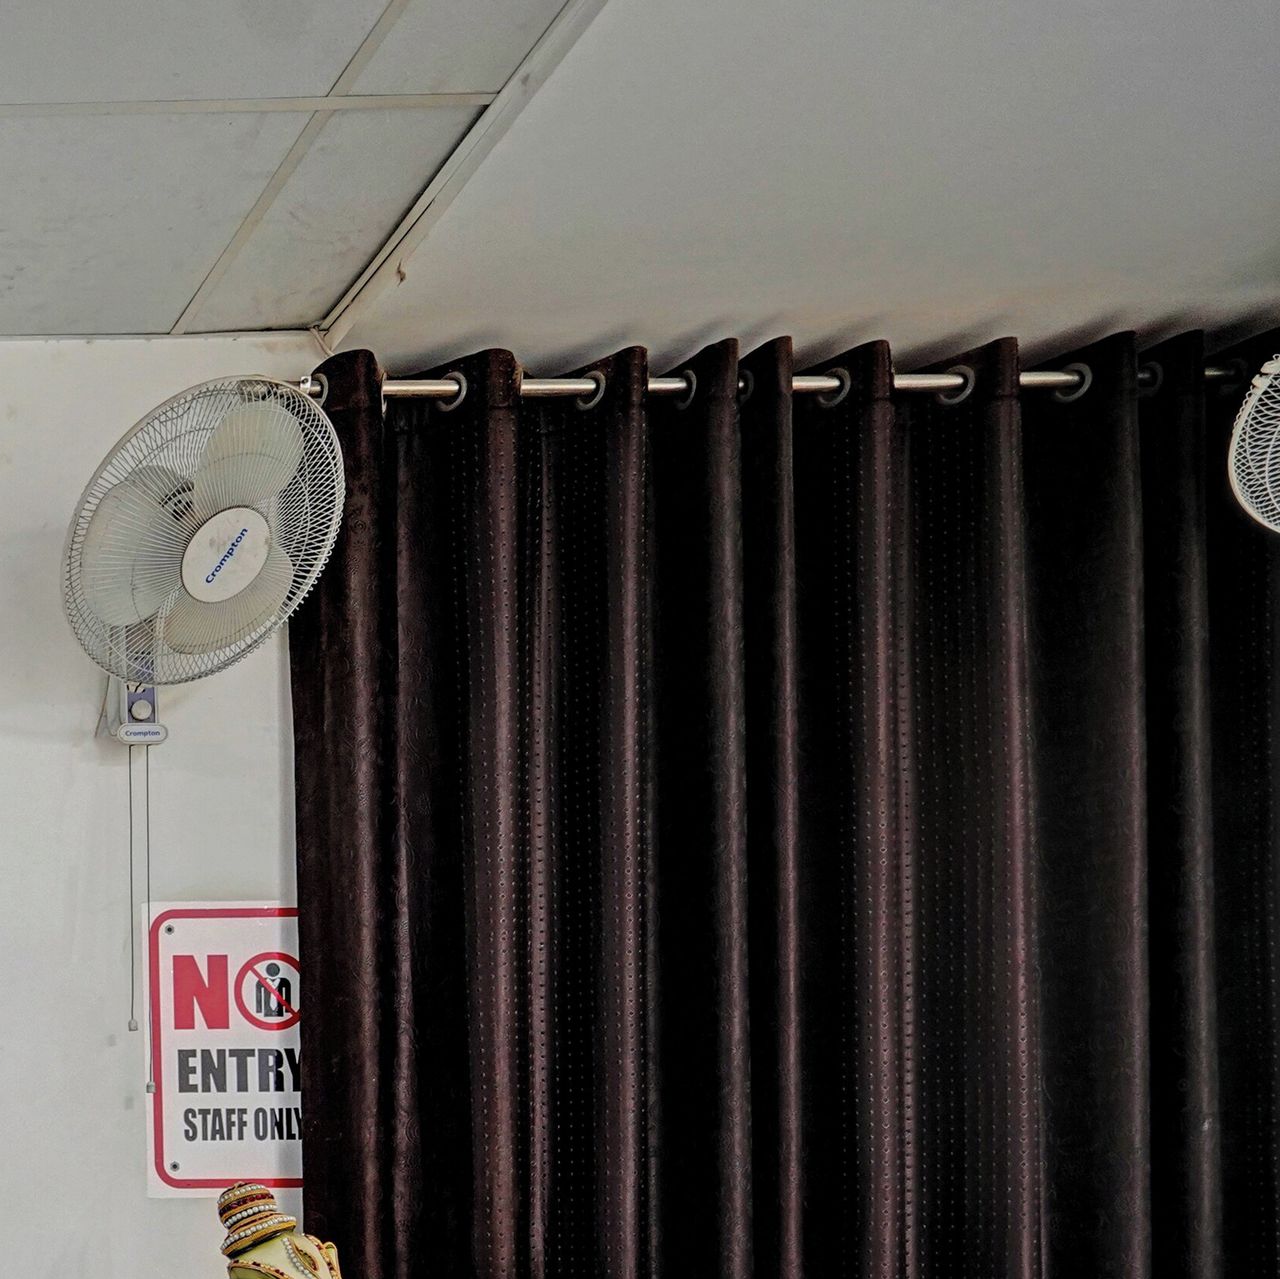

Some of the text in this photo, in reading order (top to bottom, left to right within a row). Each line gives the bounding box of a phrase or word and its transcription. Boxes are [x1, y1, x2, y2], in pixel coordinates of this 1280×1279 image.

[205, 528, 248, 584] Crompton
[125, 730, 161, 738] Crompton
[177, 1048, 302, 1093] ENTRY
[183, 1107, 248, 1142] STAFF
